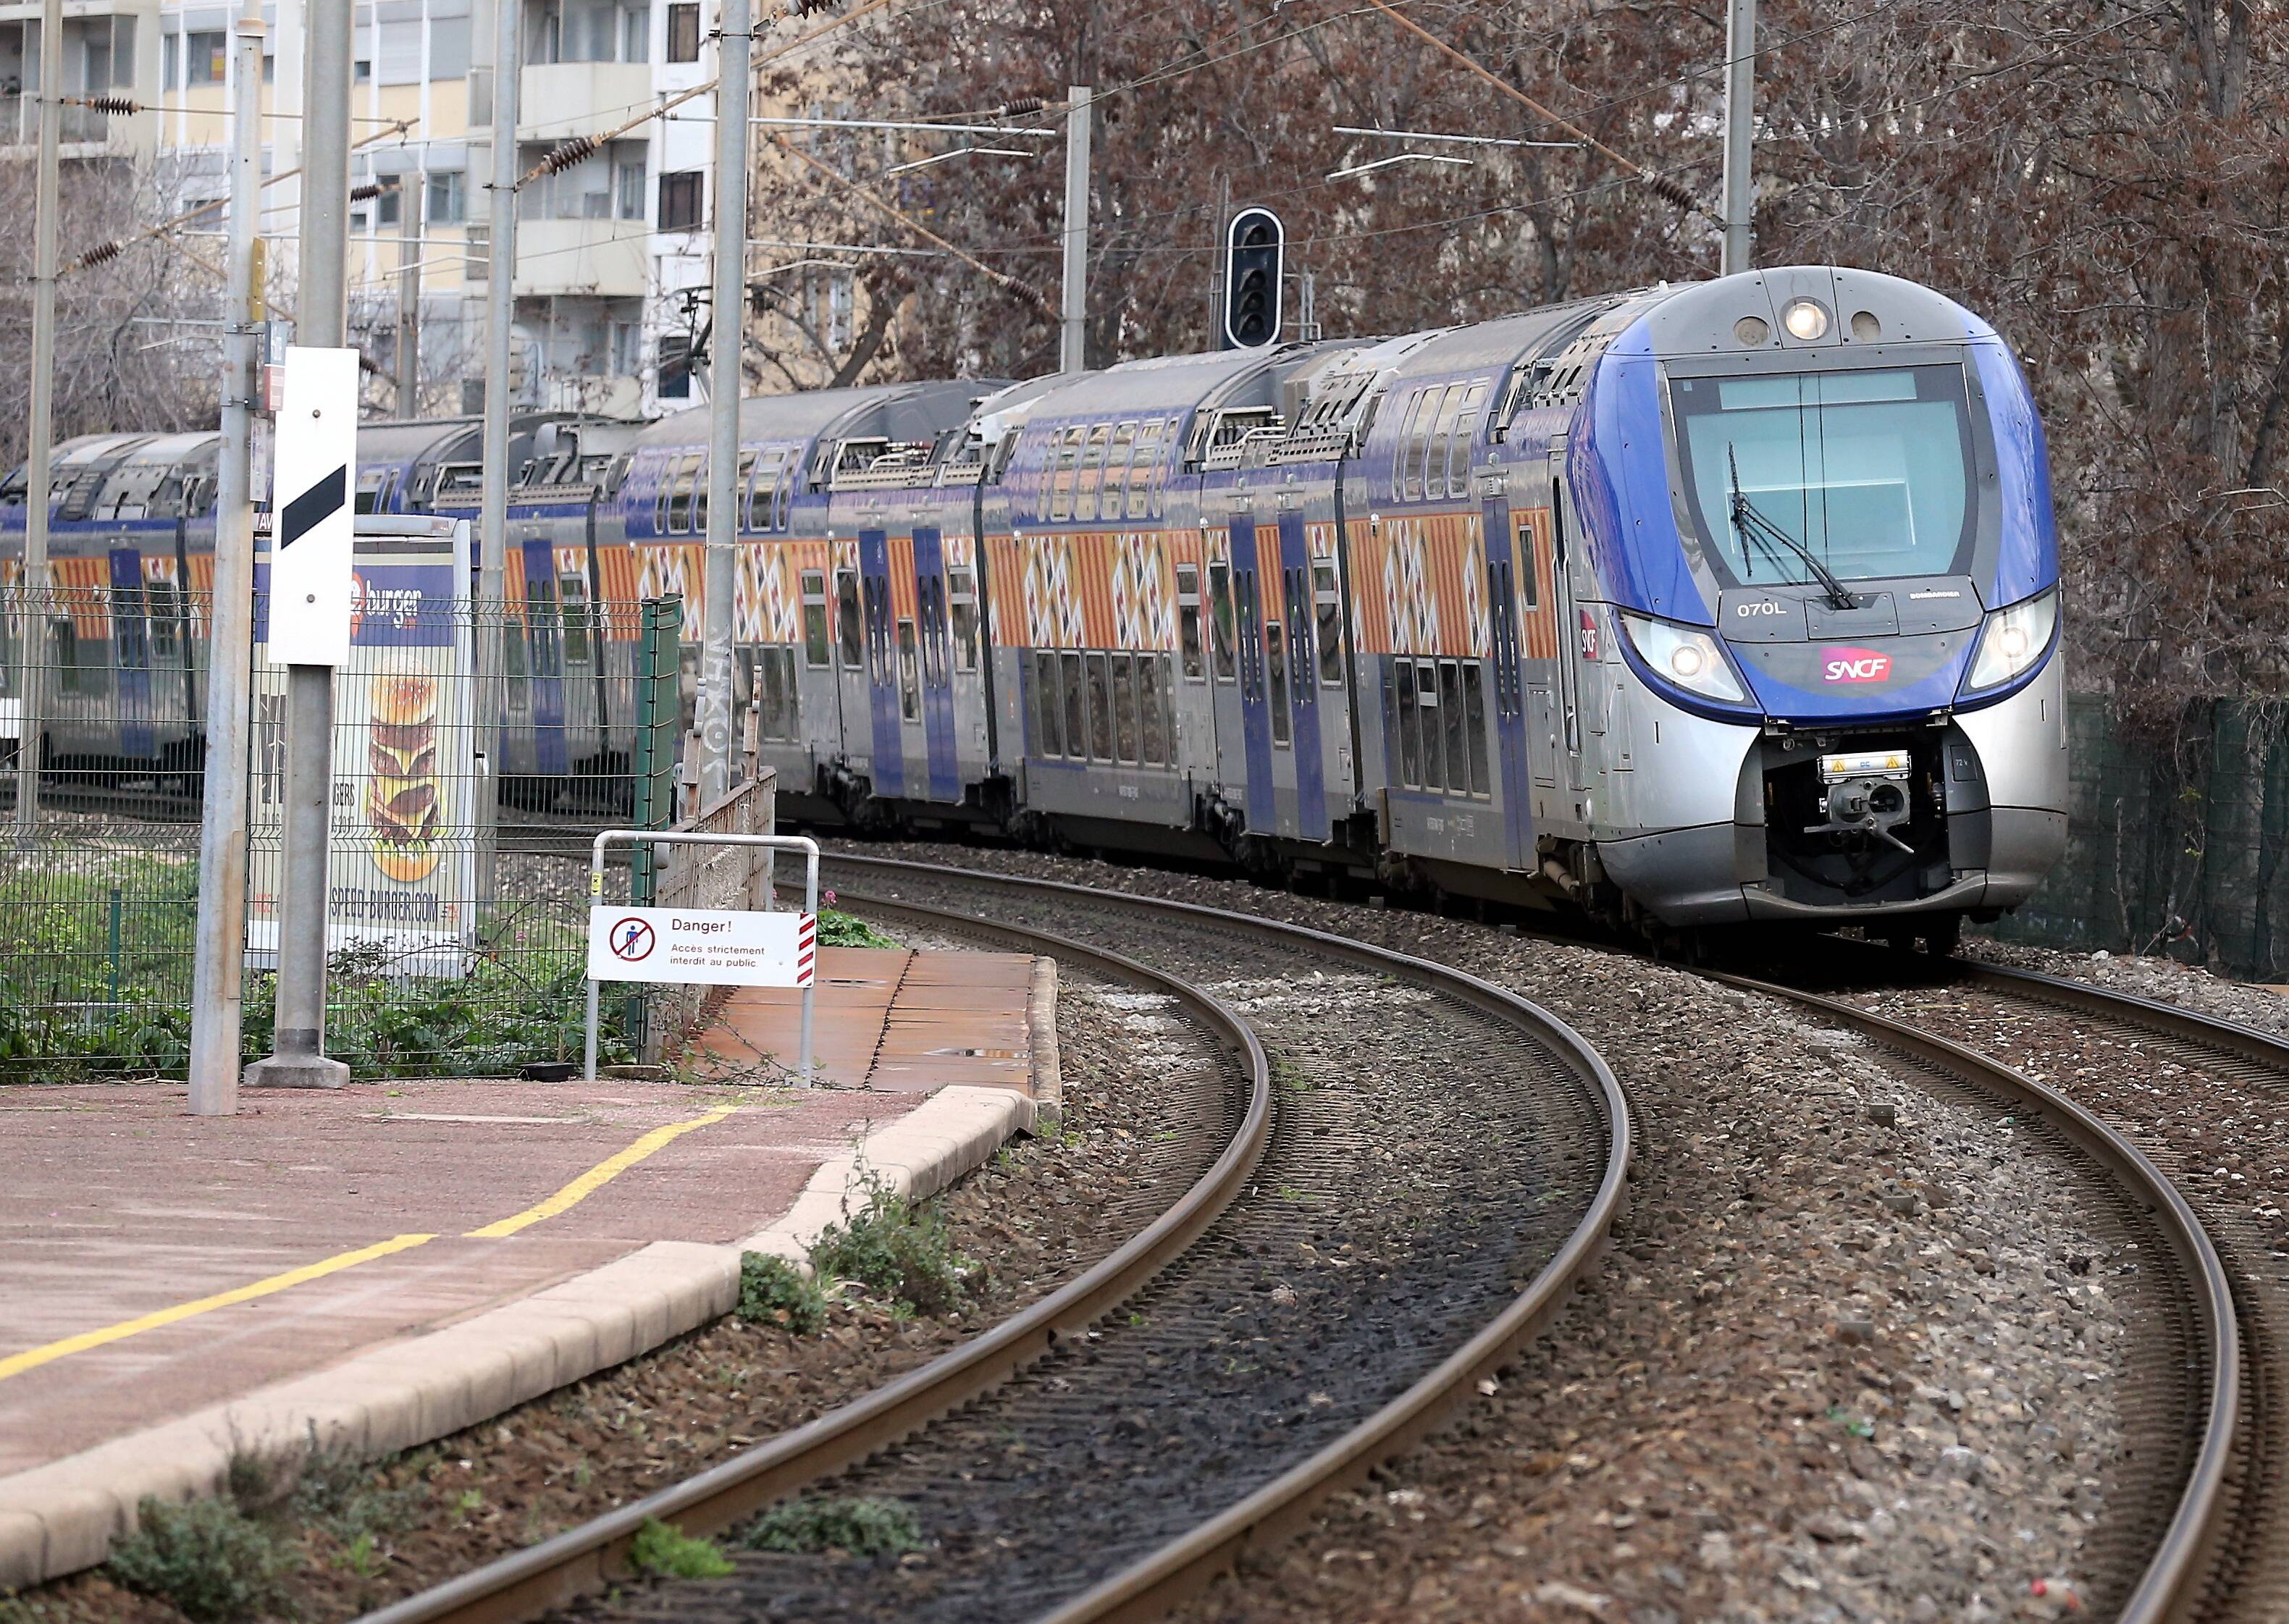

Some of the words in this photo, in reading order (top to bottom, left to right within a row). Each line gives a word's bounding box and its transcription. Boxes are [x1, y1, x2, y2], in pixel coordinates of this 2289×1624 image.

[366, 579, 422, 629] burger
[1737, 602, 1787, 617] 070L
[1825, 658, 1887, 681] SNCF
[671, 943, 702, 953] Accès
[707, 946, 765, 955] strictement
[670, 956, 705, 965] interdit
